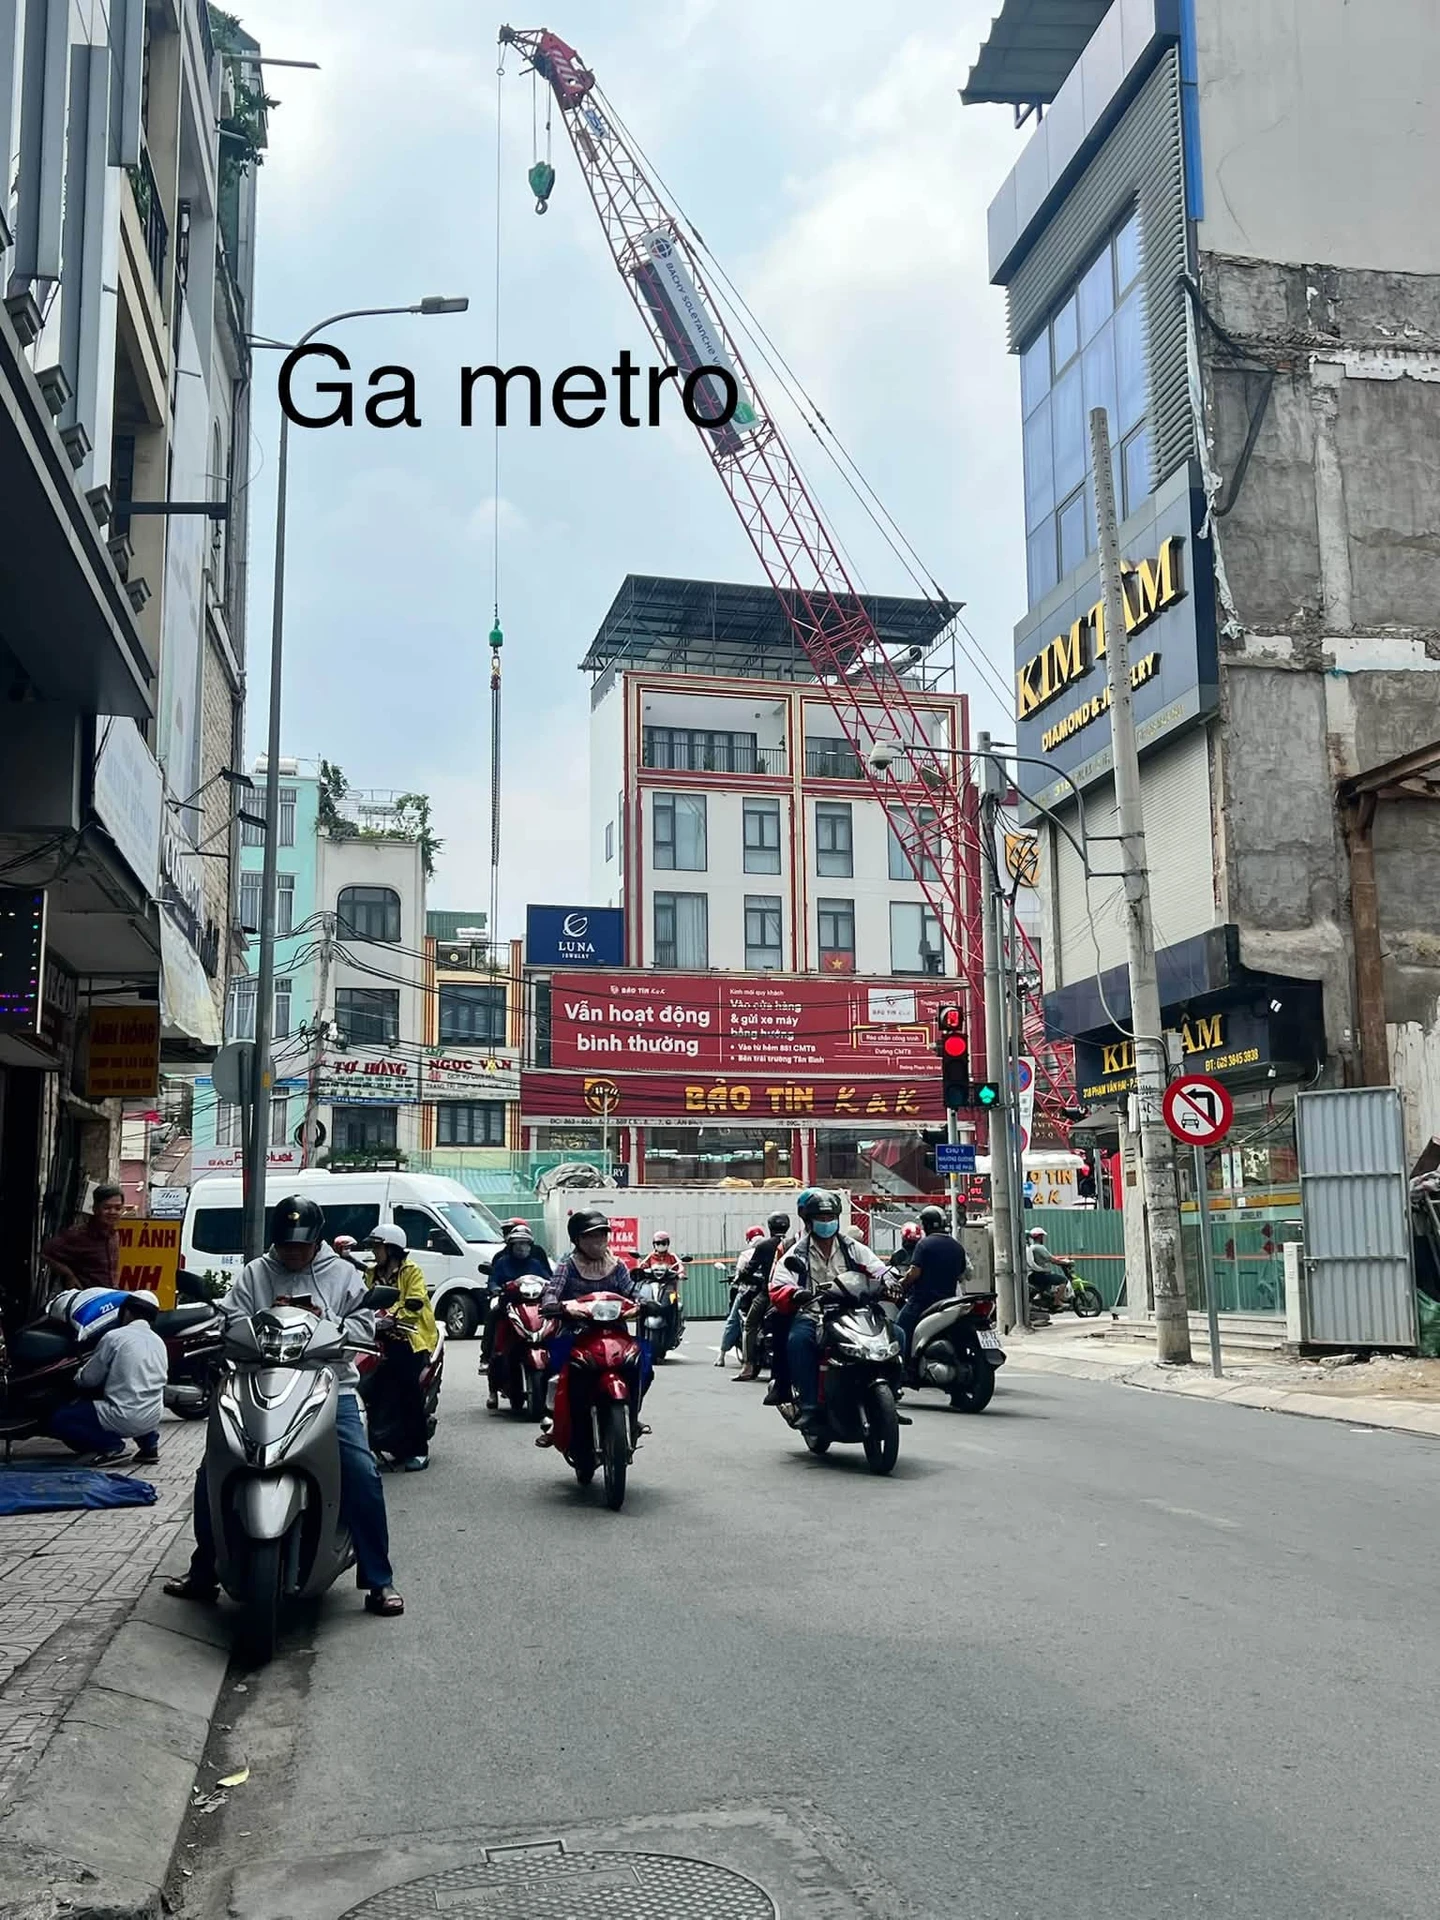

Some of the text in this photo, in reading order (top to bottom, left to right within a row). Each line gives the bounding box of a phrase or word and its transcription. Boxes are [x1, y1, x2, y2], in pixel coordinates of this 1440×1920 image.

[665, 262, 686, 294] BACHY
[1016, 613, 1085, 722] KIM
[1041, 702, 1091, 752] DIAMOND
[1091, 695, 1100, 717] &
[1101, 652, 1156, 710] JLRY
[558, 941, 595, 952] LUNA
[564, 1000, 710, 1028] Vẫn hoạt động
[730, 1013, 739, 1024] &
[740, 1014, 758, 1026] gửi
[776, 1016, 798, 1027] máy
[577, 1032, 699, 1057] bình thường
[1101, 1014, 1224, 1075] KI ÂM
[685, 1078, 751, 1114] BẢO
[765, 1080, 814, 1113] TÍN
[139, 1223, 177, 1248] ẢNH
[101, 1302, 115, 1314] 221
